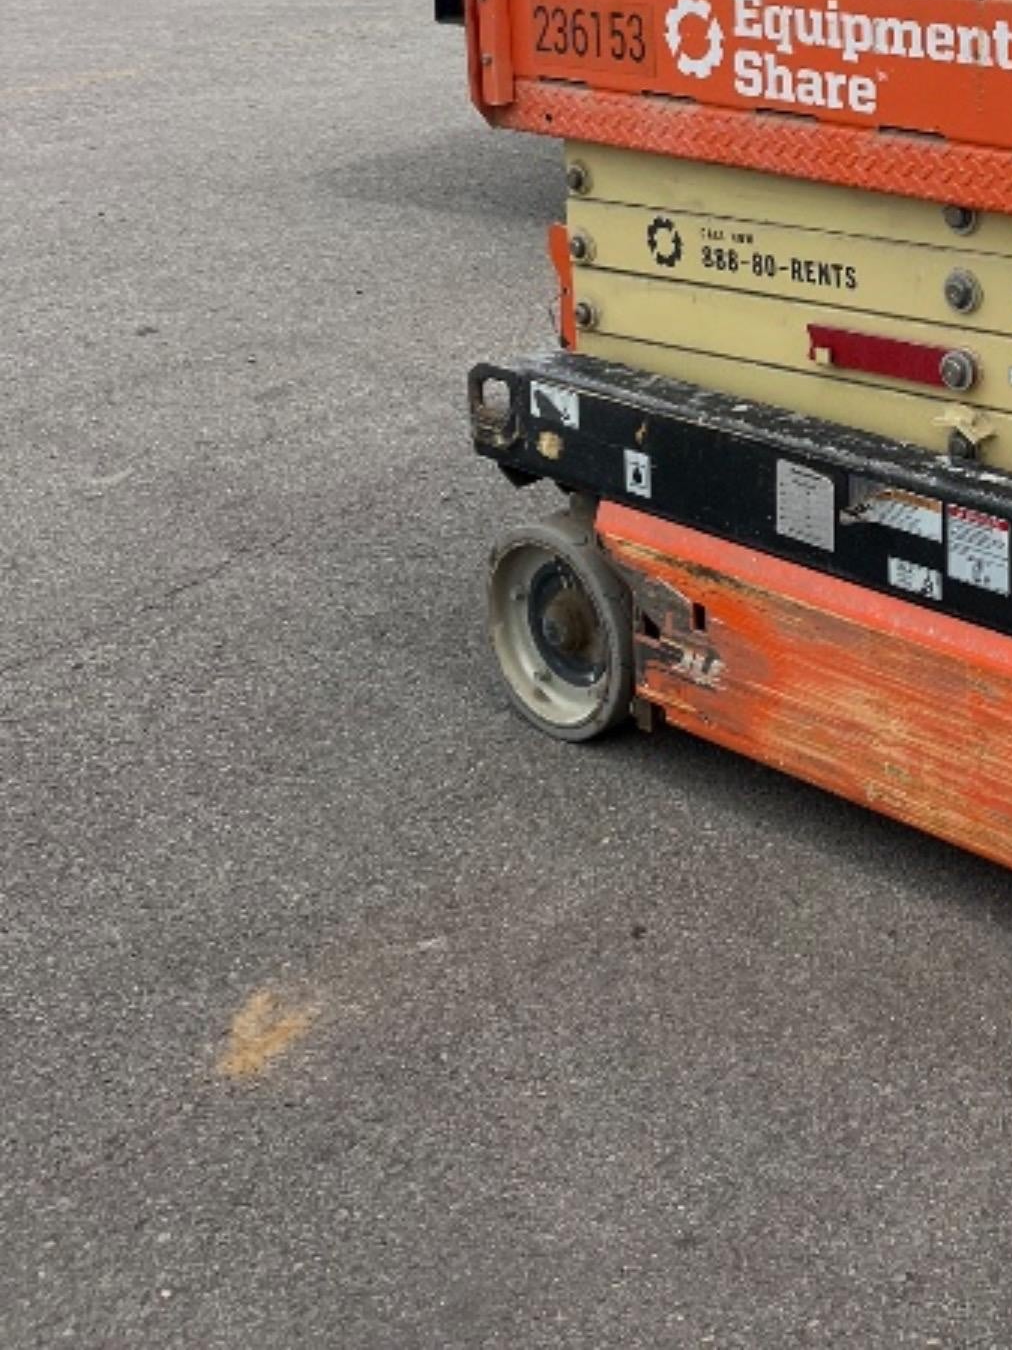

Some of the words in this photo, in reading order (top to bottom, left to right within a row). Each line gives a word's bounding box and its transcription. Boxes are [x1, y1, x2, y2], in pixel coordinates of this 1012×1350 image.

[533, 5, 646, 63] 236153
[732, 51, 877, 114] Share
[702, 245, 858, 290] 888-80-RENTS
